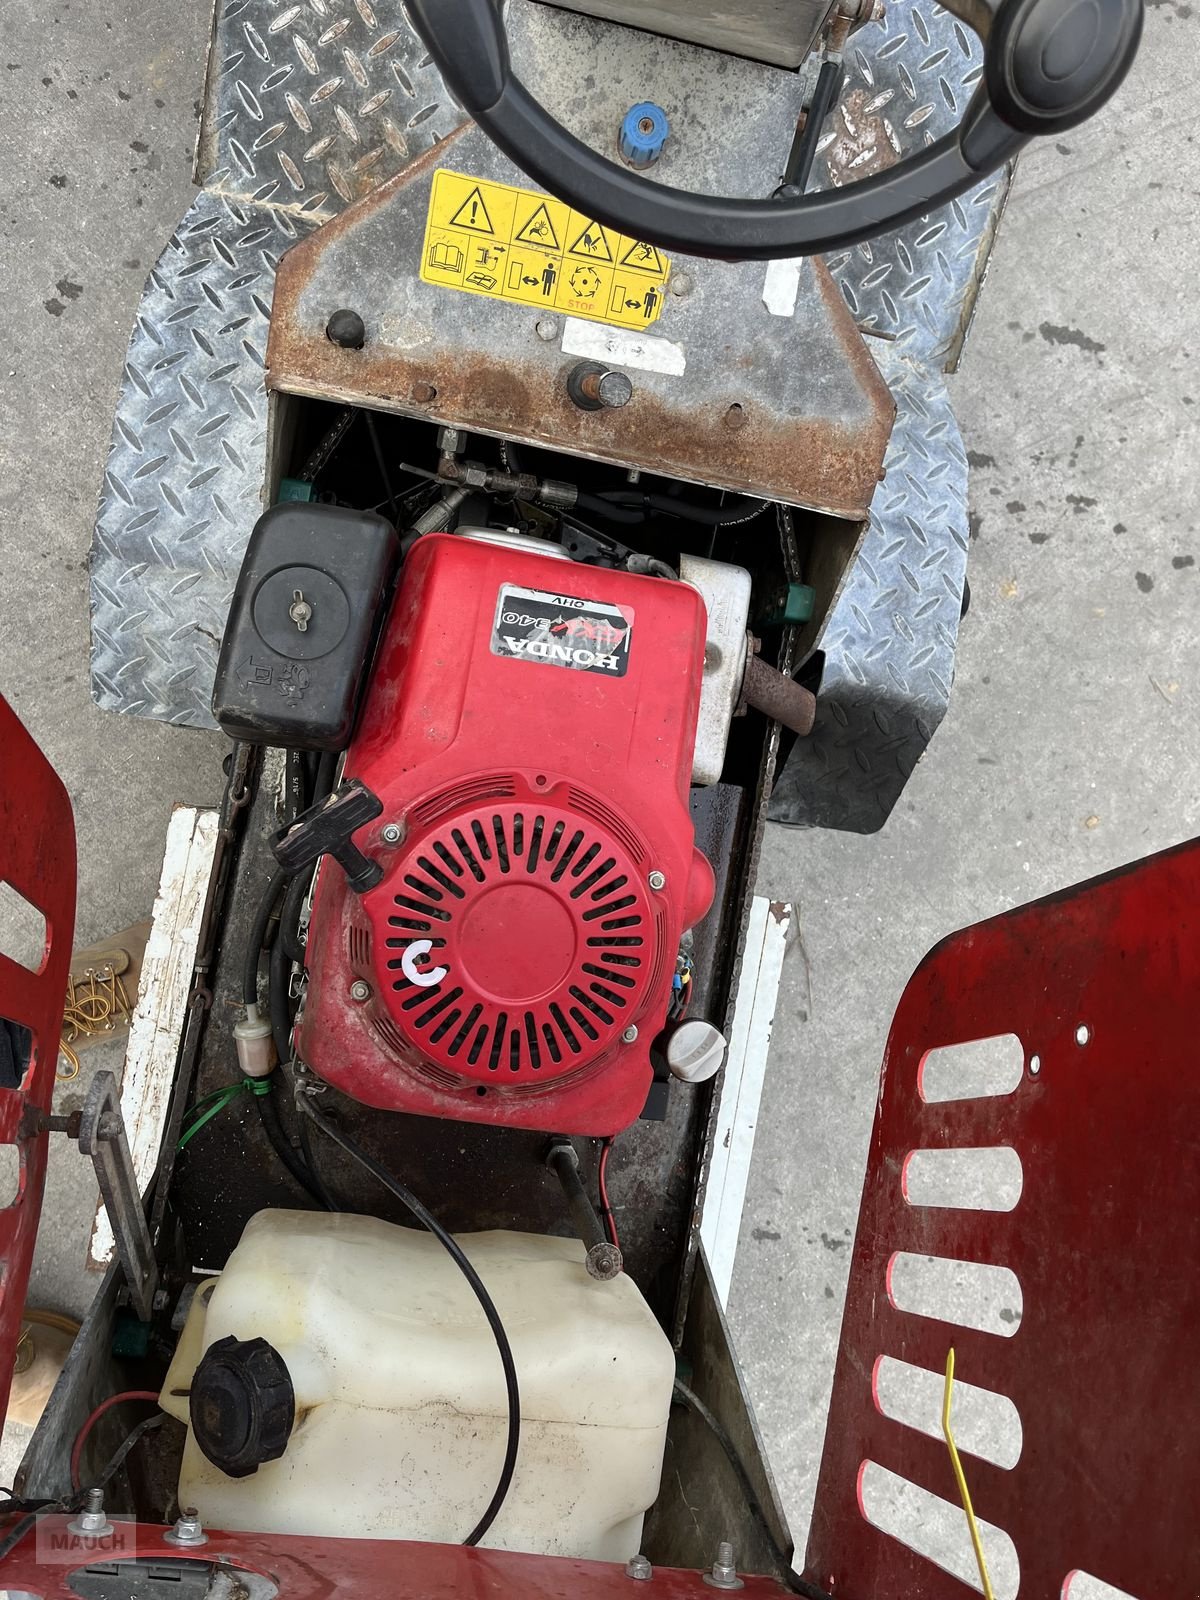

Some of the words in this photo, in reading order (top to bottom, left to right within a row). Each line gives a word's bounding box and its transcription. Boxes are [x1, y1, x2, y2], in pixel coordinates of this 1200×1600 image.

[568, 299, 595, 311] STOP
[552, 597, 585, 608] OHV
[502, 612, 551, 631] 340
[503, 636, 620, 671] HONDA
